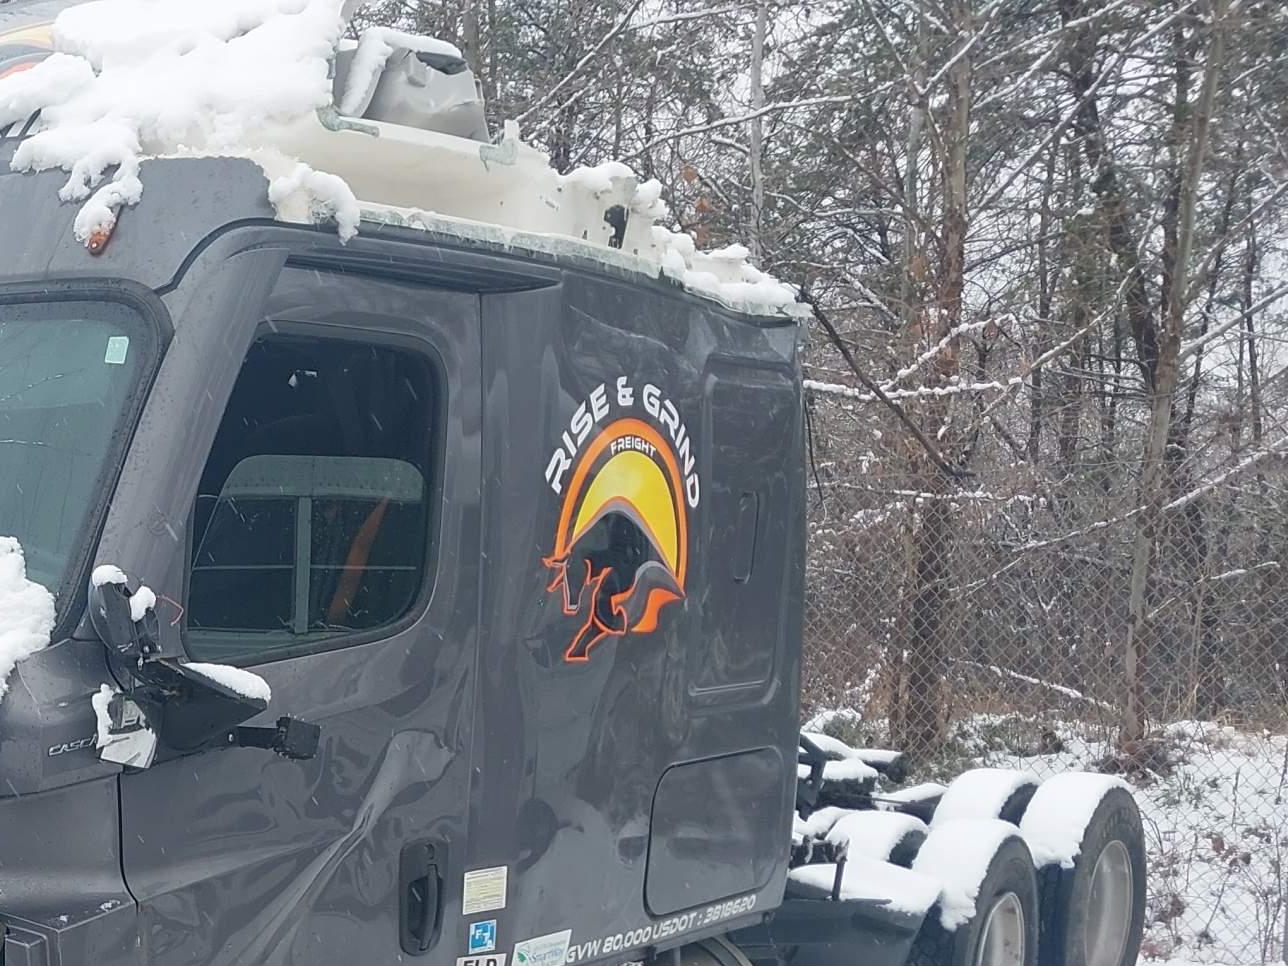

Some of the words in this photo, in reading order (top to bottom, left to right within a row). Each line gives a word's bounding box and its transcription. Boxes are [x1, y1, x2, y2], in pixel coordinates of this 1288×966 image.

[545, 383, 612, 496] RISE
[616, 375, 635, 407] &
[642, 383, 701, 509] GRIND
[610, 435, 658, 458] FREIGHT
[566, 939, 604, 964] GVW
[602, 926, 653, 954] 80,000
[652, 911, 697, 940] USDOT
